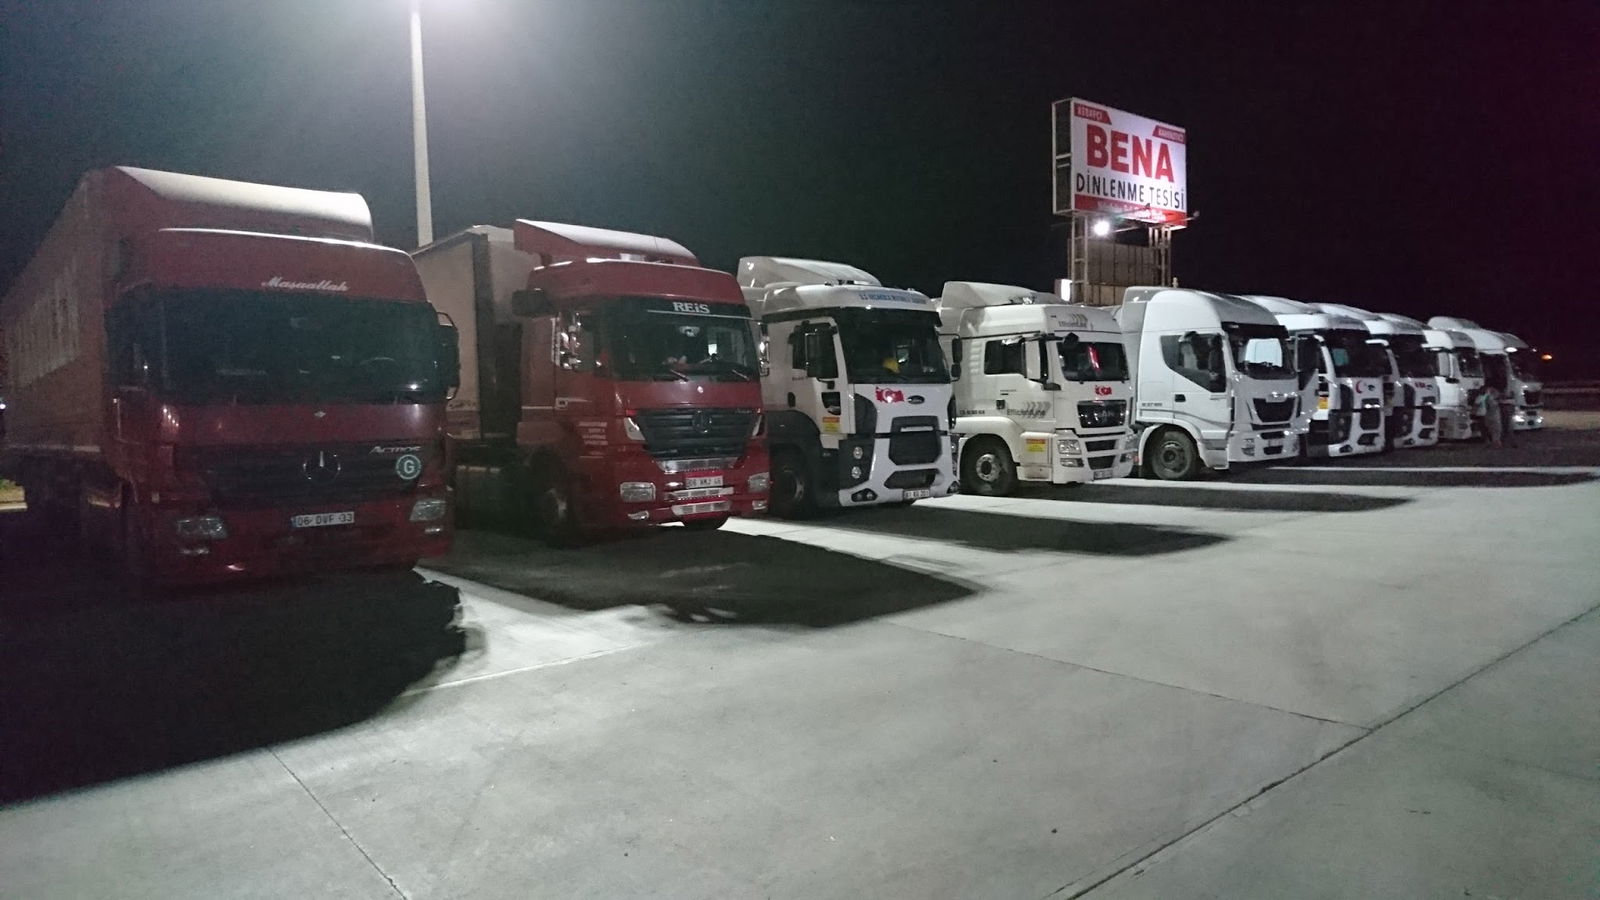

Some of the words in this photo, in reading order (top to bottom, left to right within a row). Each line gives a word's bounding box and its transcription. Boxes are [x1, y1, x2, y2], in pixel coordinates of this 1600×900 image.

[1087, 124, 1175, 183] BENA
[1077, 170, 1145, 203] DİNLENME
[404, 460, 415, 474] G
